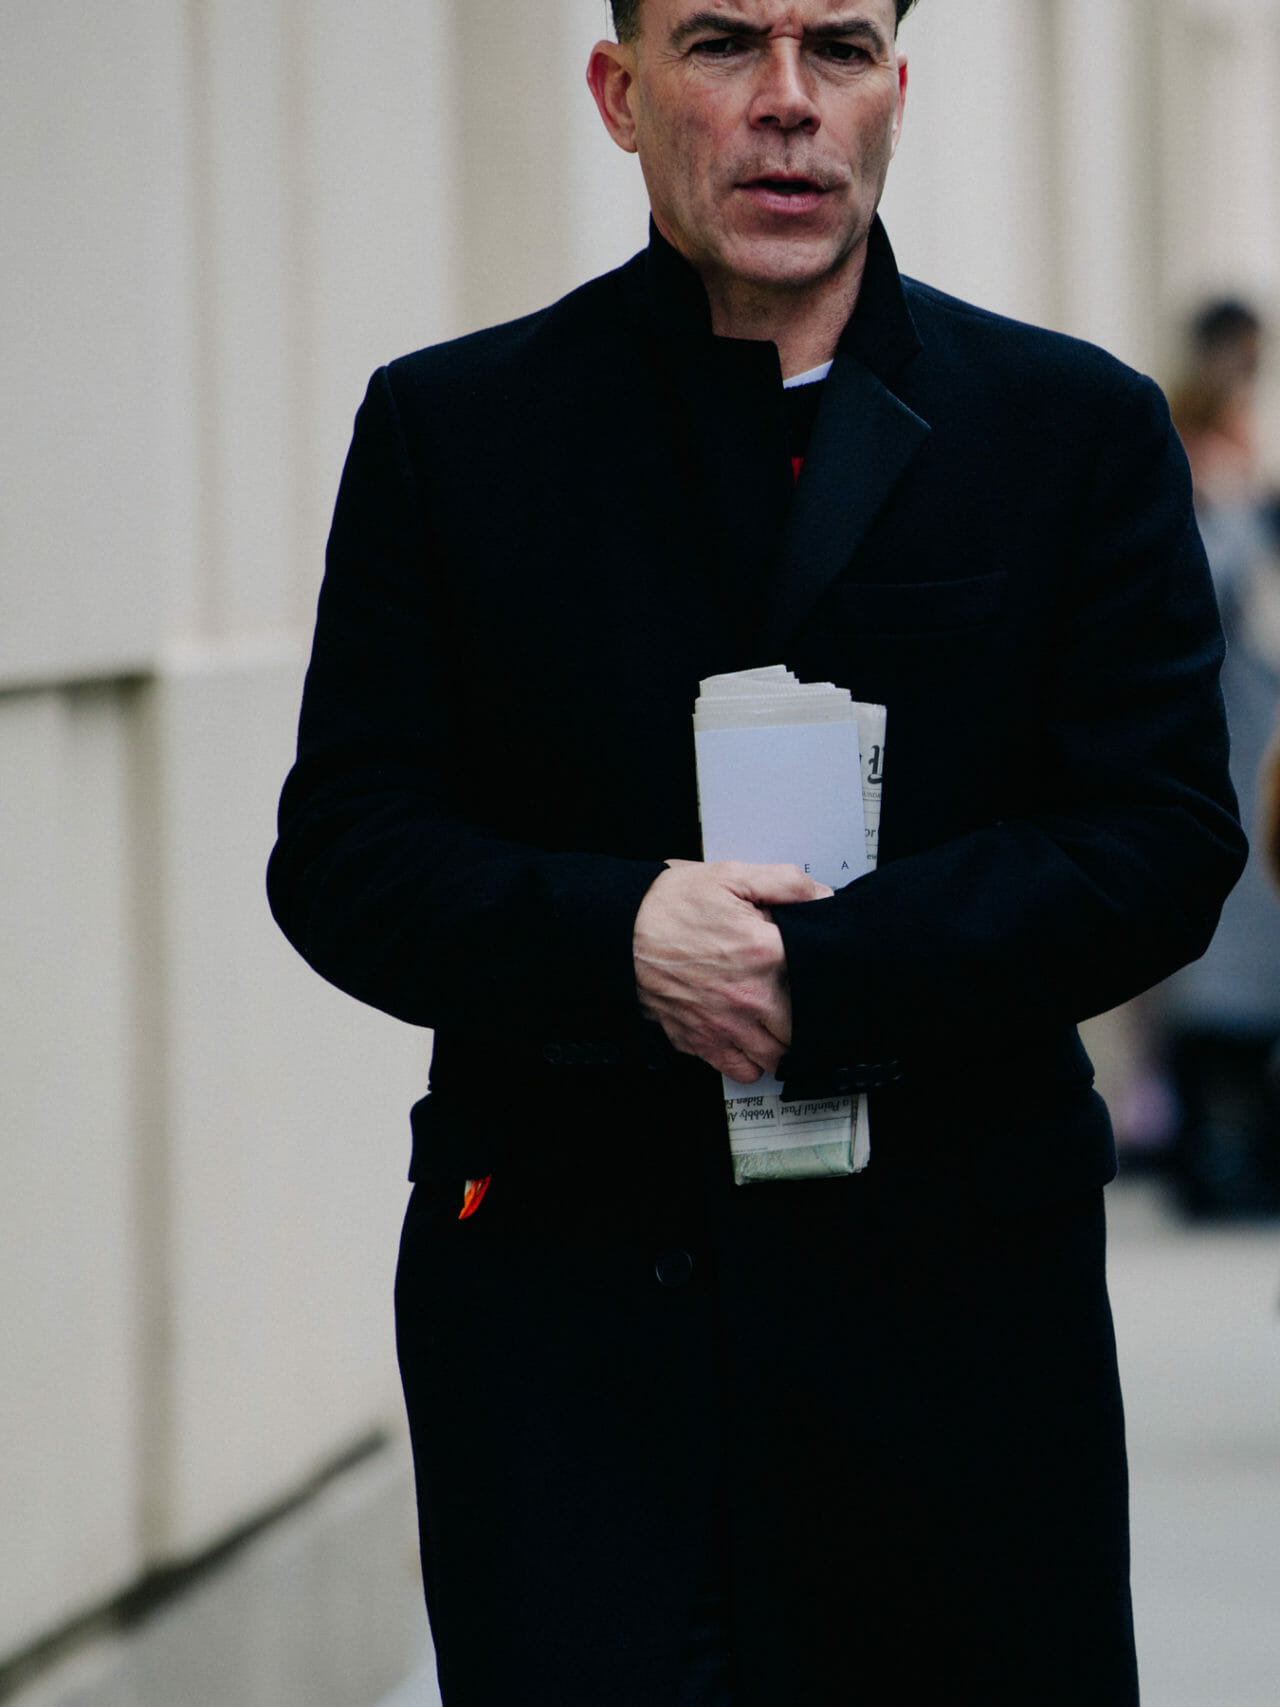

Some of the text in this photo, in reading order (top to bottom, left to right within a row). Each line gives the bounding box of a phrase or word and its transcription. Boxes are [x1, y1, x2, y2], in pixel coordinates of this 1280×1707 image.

[740, 1108, 774, 1121] Wobbly
[781, 1104, 801, 1116] Past
[805, 1102, 840, 1115] Painful
